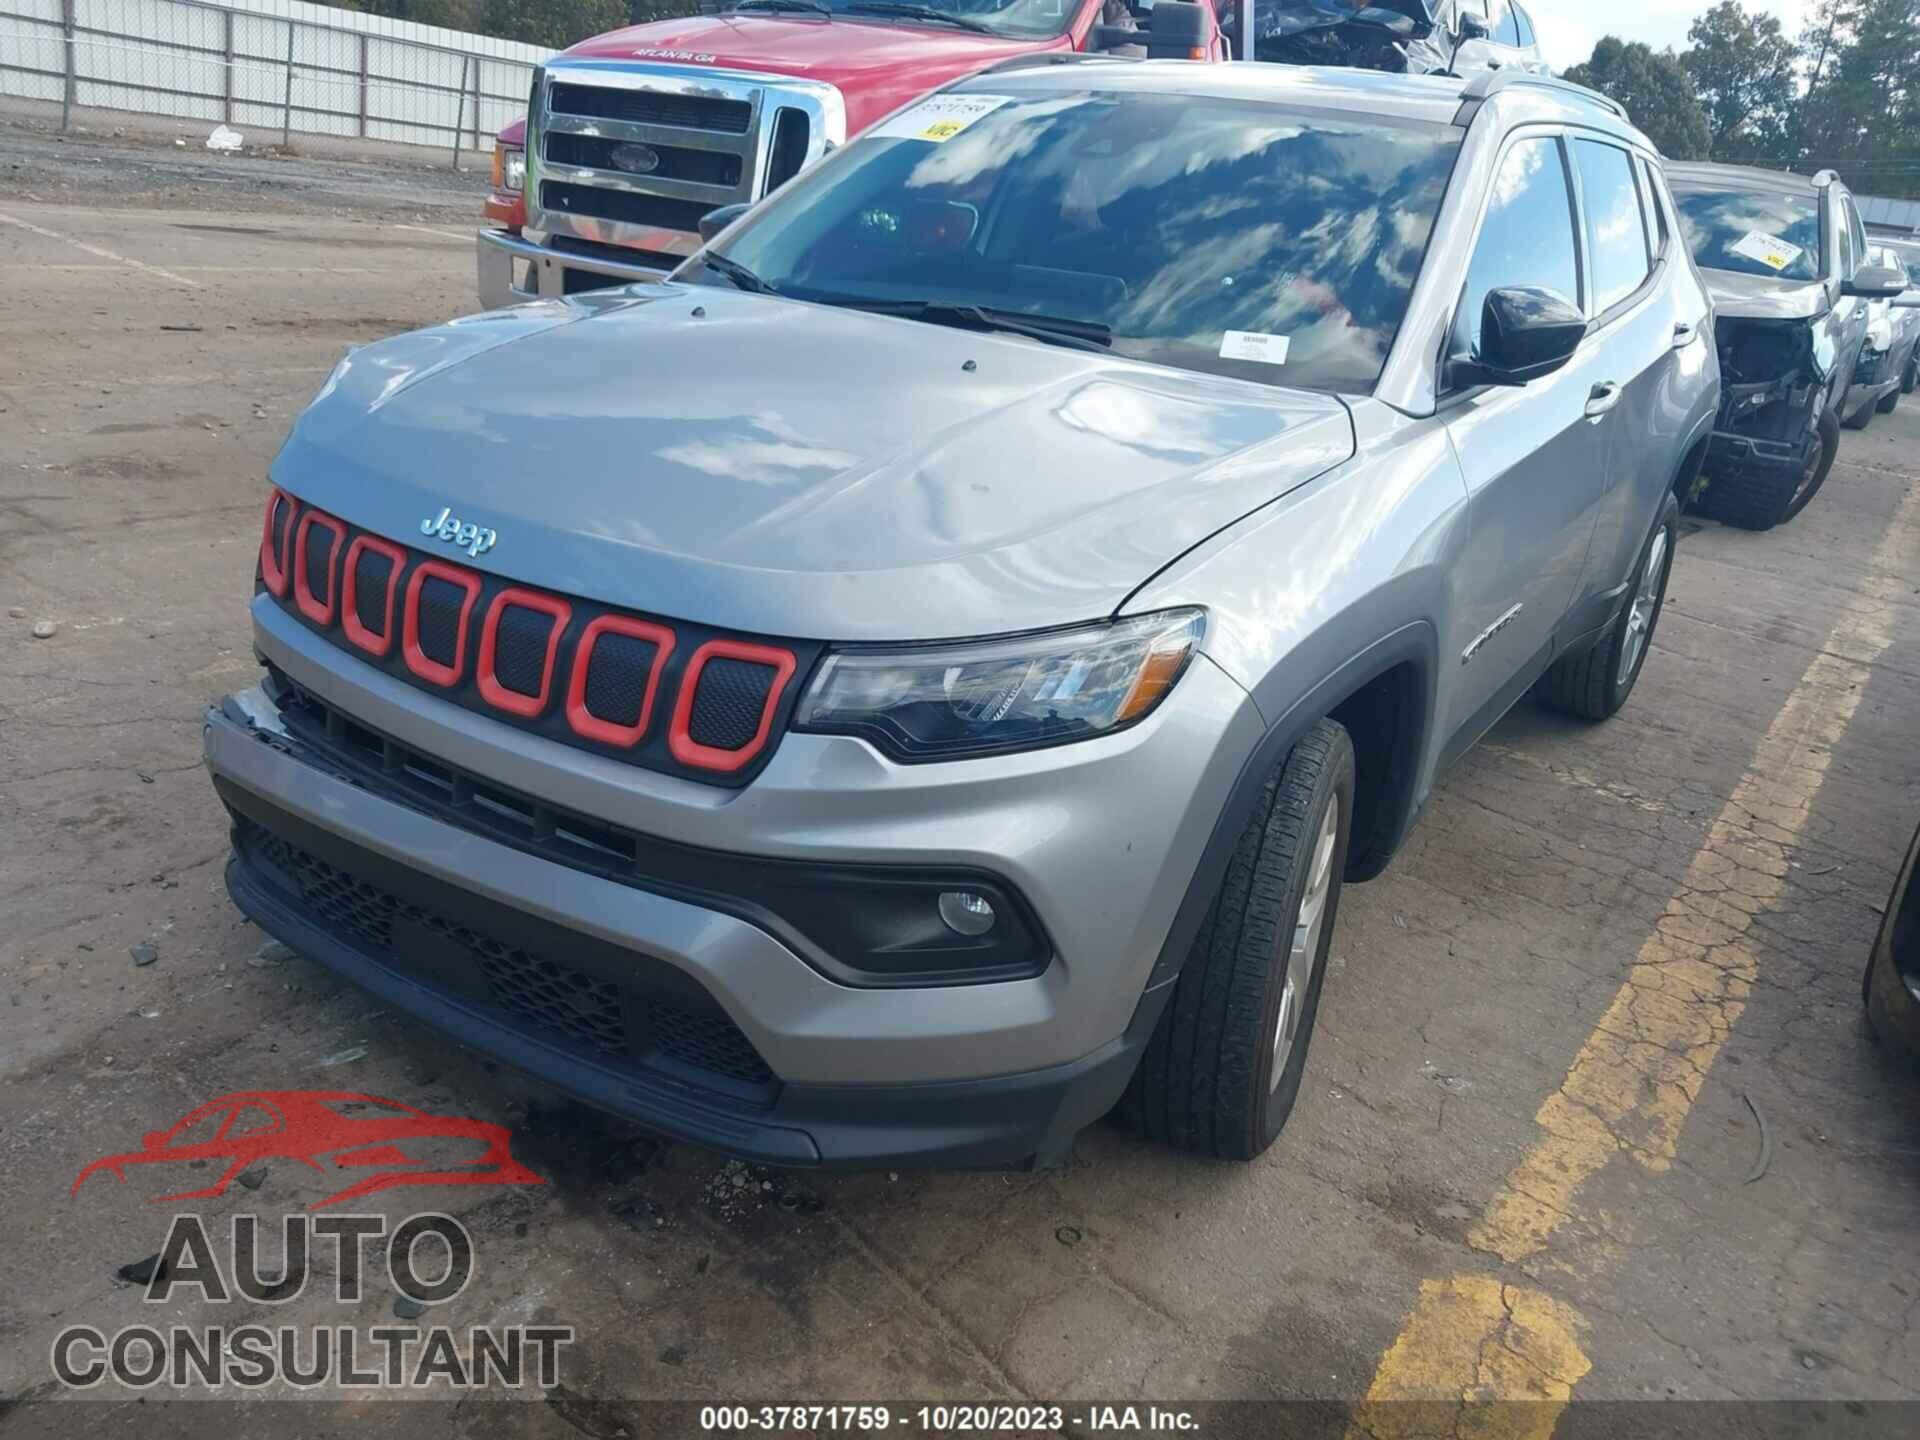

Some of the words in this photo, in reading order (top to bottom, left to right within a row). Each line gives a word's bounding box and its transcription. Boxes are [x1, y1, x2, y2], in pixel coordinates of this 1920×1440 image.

[632, 47, 693, 60] ATLANTA
[695, 53, 717, 63] GA
[420, 507, 497, 558] Jeep
